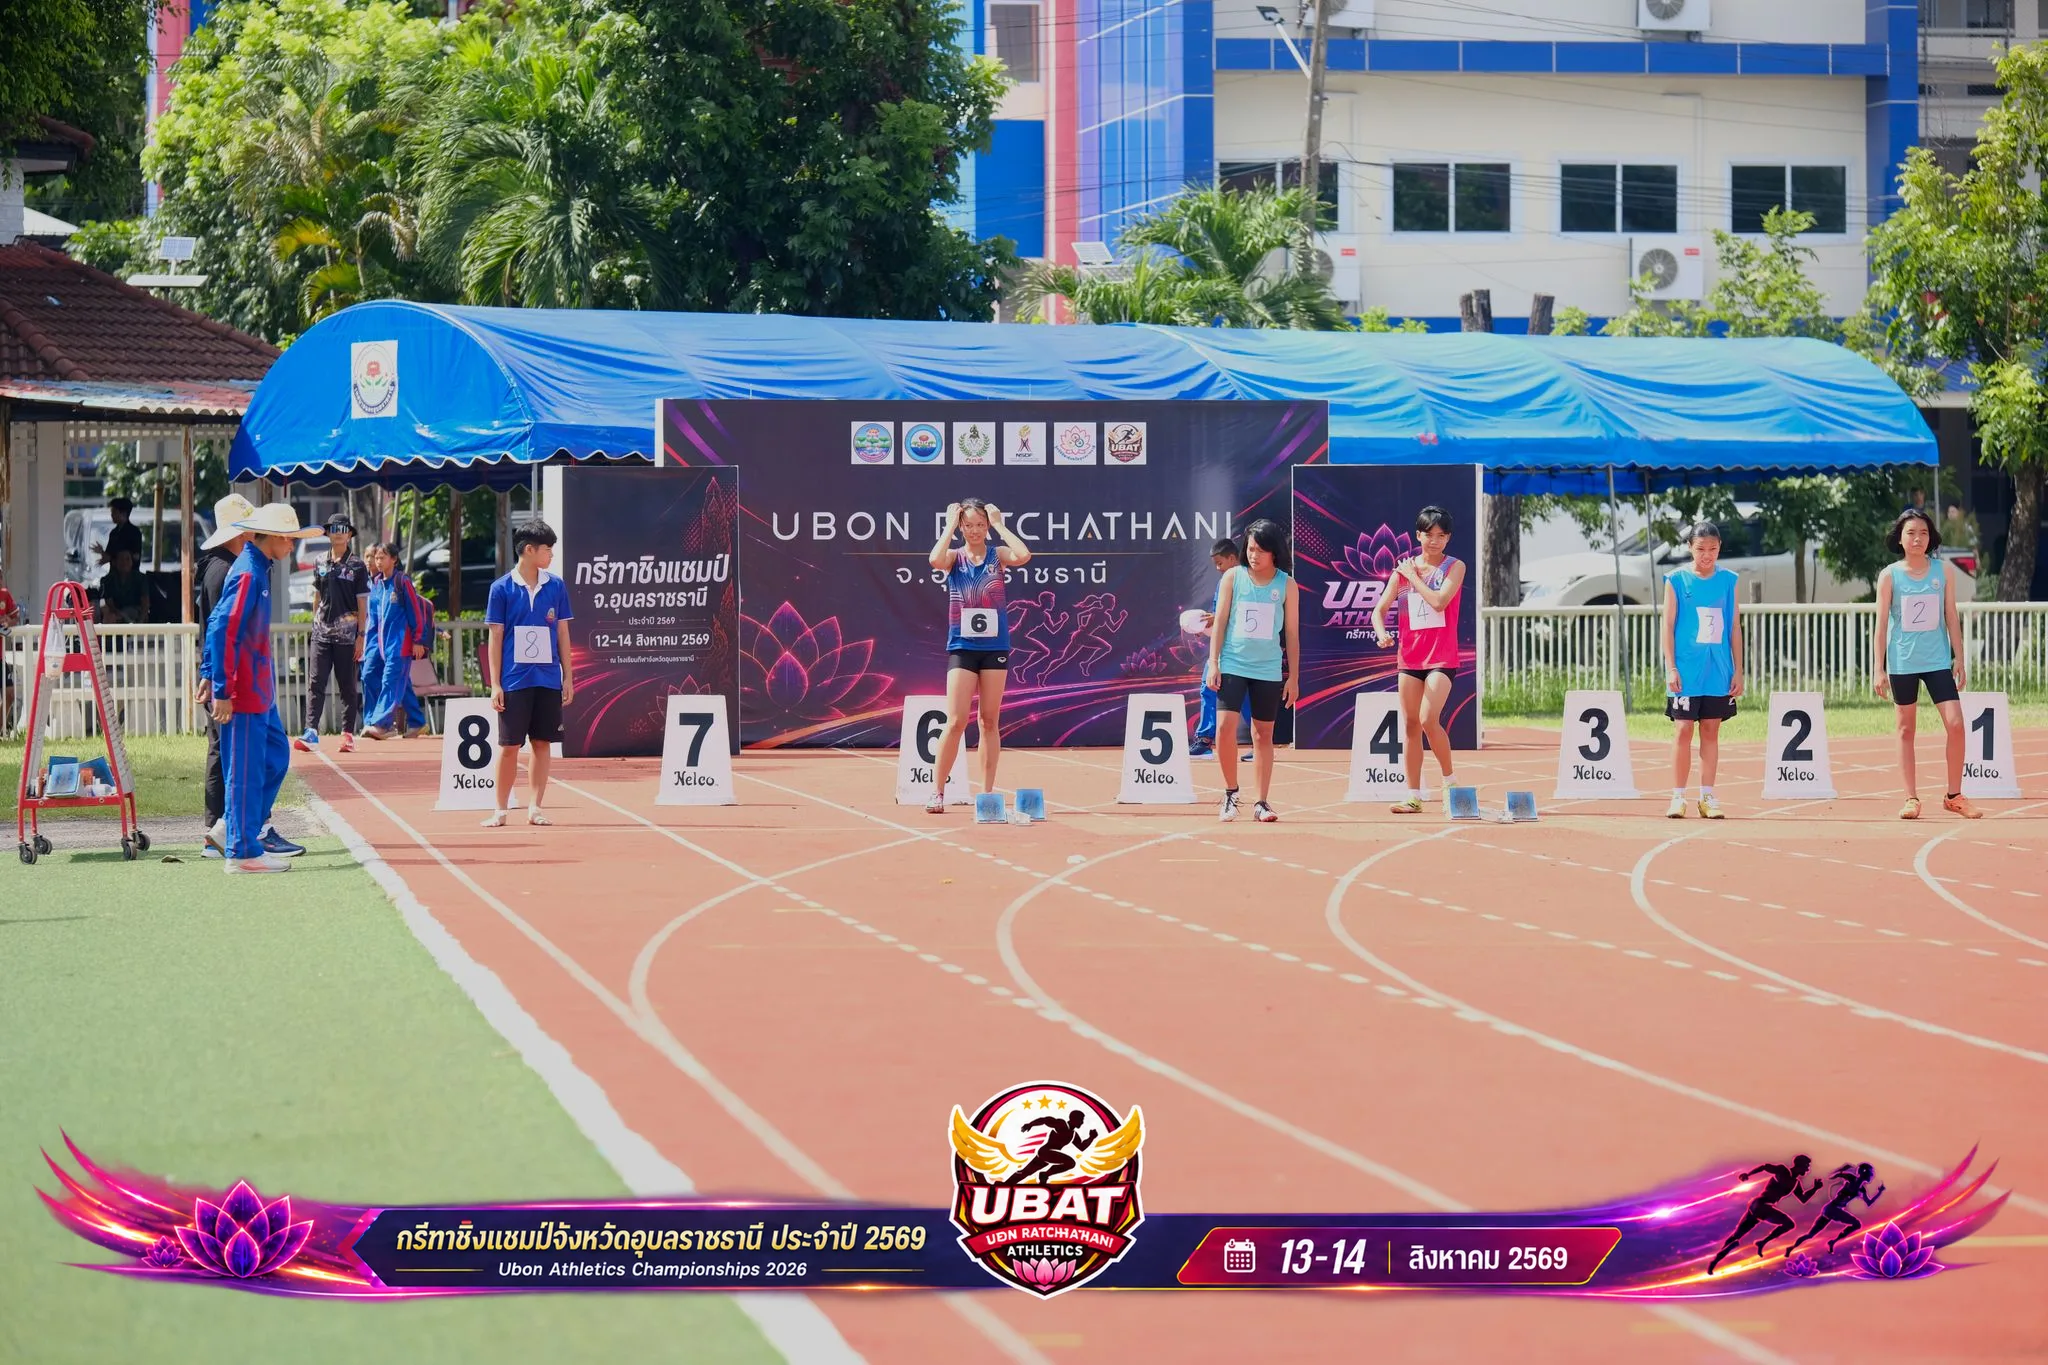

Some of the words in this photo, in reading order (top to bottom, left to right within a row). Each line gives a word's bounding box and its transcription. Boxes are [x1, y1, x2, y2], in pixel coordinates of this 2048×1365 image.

[1111, 443, 1140, 452] UBAT
[772, 512, 910, 541] UBON
[935, 512, 1231, 541] RCHATHANI
[895, 560, 1108, 592] จ.อุราชธานี
[594, 586, 708, 614] จ.อุบลราชธานี
[1417, 600, 1429, 624] 4
[628, 616, 655, 626] ประจำปี
[657, 616, 675, 625] 2569
[970, 613, 988, 633] 6
[1244, 609, 1259, 633] 5
[1911, 601, 1926, 624] 2
[524, 631, 539, 658] 8
[636, 634, 678, 646] สิงหาคม
[681, 633, 710, 645] 2569
[457, 715, 492, 769] 8
[679, 713, 714, 767] 7
[916, 710, 947, 764] 6
[1139, 711, 1174, 765] 5
[1370, 710, 1403, 764] 4
[1578, 708, 1611, 761] 3
[1781, 709, 1813, 761] 2
[1971, 708, 1994, 760] 1
[453, 774, 494, 789] Nelco
[674, 771, 715, 787] Nelco
[911, 768, 952, 784] Nelo
[1134, 769, 1174, 784] Nelco
[1366, 768, 1405, 783] Nelco
[1573, 765, 1612, 780] Nelco
[1777, 767, 1815, 781] Nelco
[1963, 763, 1999, 778] Nelco
